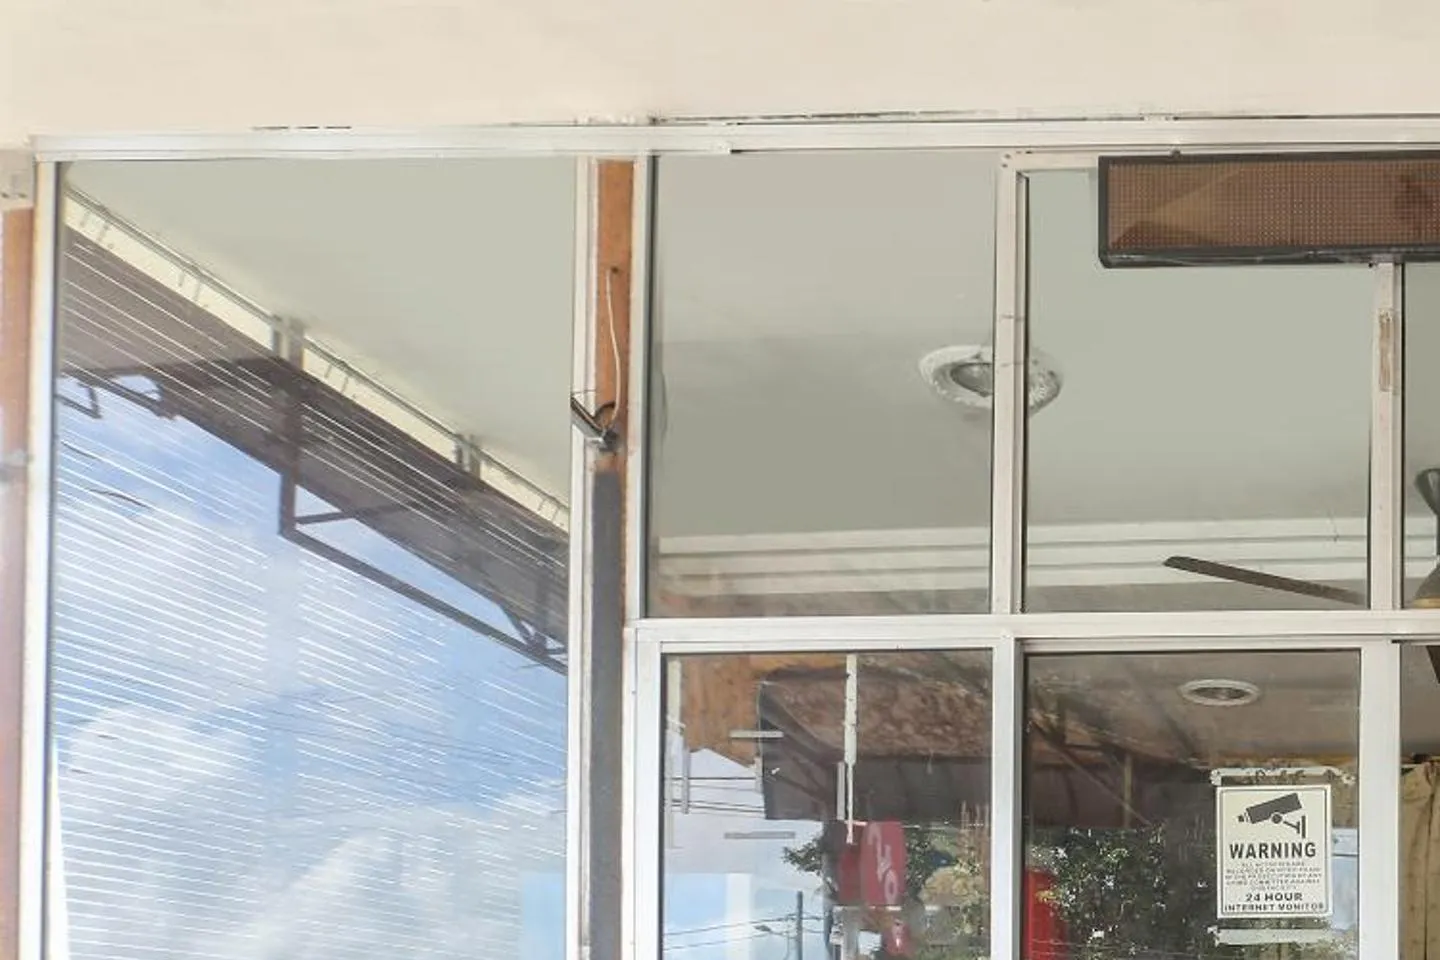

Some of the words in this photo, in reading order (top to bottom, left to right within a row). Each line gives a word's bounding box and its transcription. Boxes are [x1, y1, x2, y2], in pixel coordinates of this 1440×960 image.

[1229, 842, 1317, 860] WARNING
[1245, 892, 1261, 902] 24
[1264, 891, 1303, 902] HOUR
[1224, 903, 1275, 912] INTERNET
[1278, 901, 1325, 911] MONITOR
